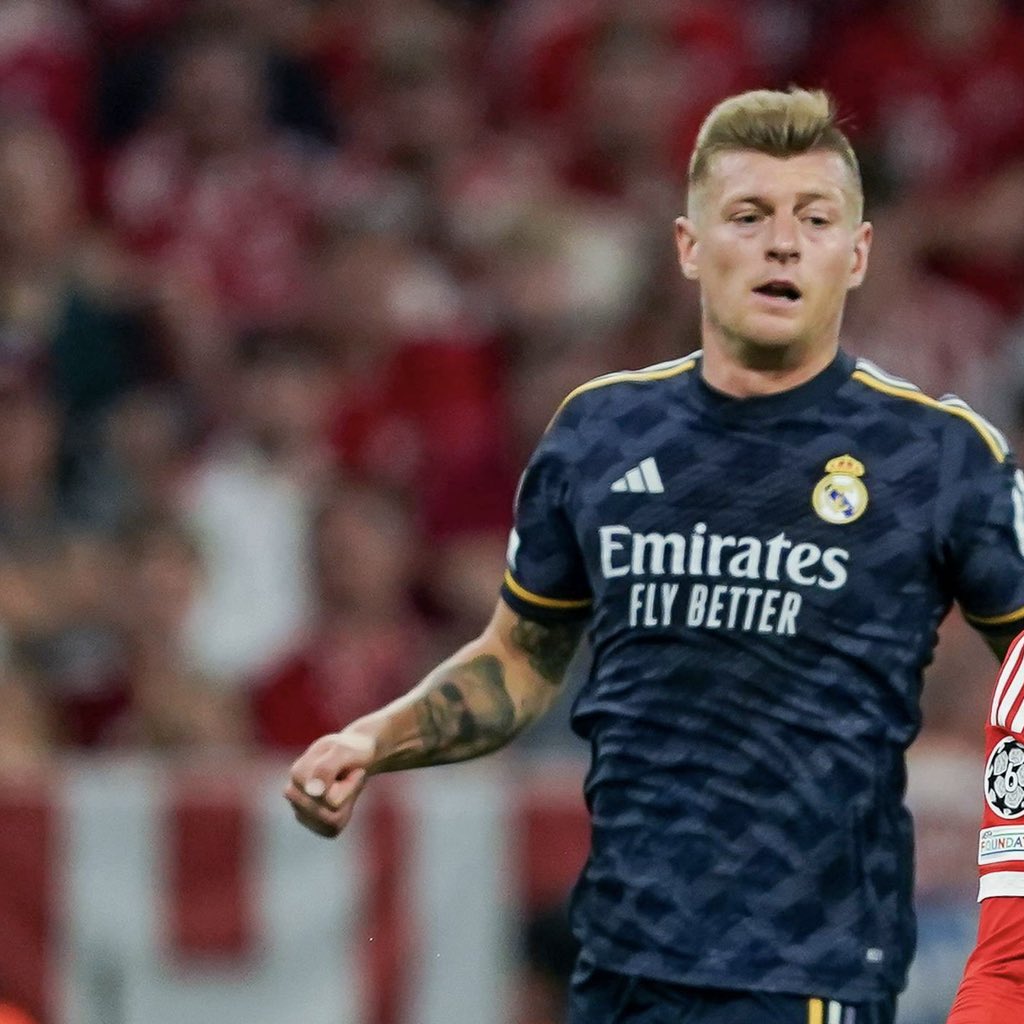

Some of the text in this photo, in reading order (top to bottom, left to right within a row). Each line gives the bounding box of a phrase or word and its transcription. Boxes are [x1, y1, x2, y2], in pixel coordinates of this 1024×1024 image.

[598, 521, 850, 590] Emirates
[629, 583, 803, 636] FLY BETTER
